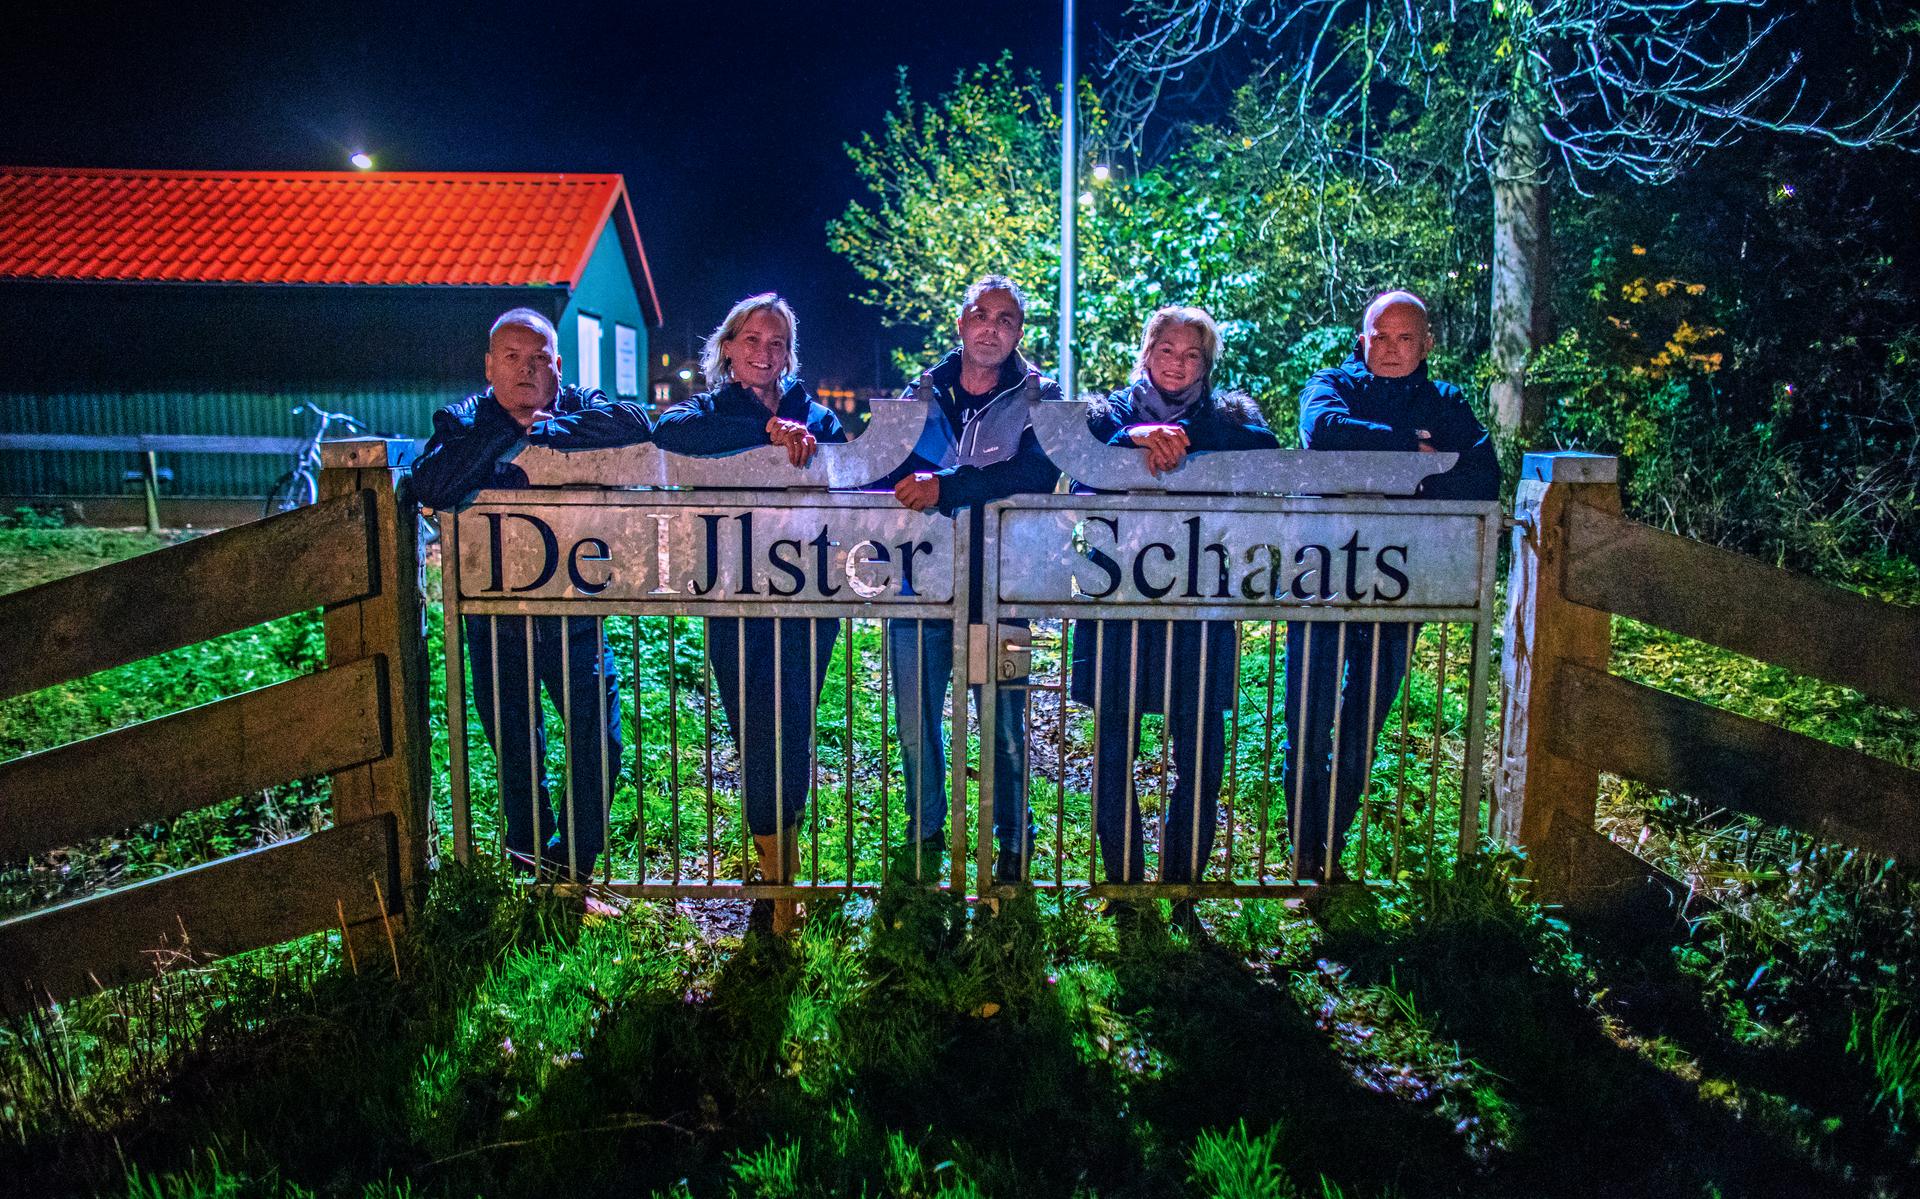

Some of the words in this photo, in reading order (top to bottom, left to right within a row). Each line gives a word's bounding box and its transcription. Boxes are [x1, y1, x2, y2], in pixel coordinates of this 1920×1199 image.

[478, 512, 613, 595] De
[646, 511, 934, 599] IJlster
[1071, 516, 1411, 601] Schaats
